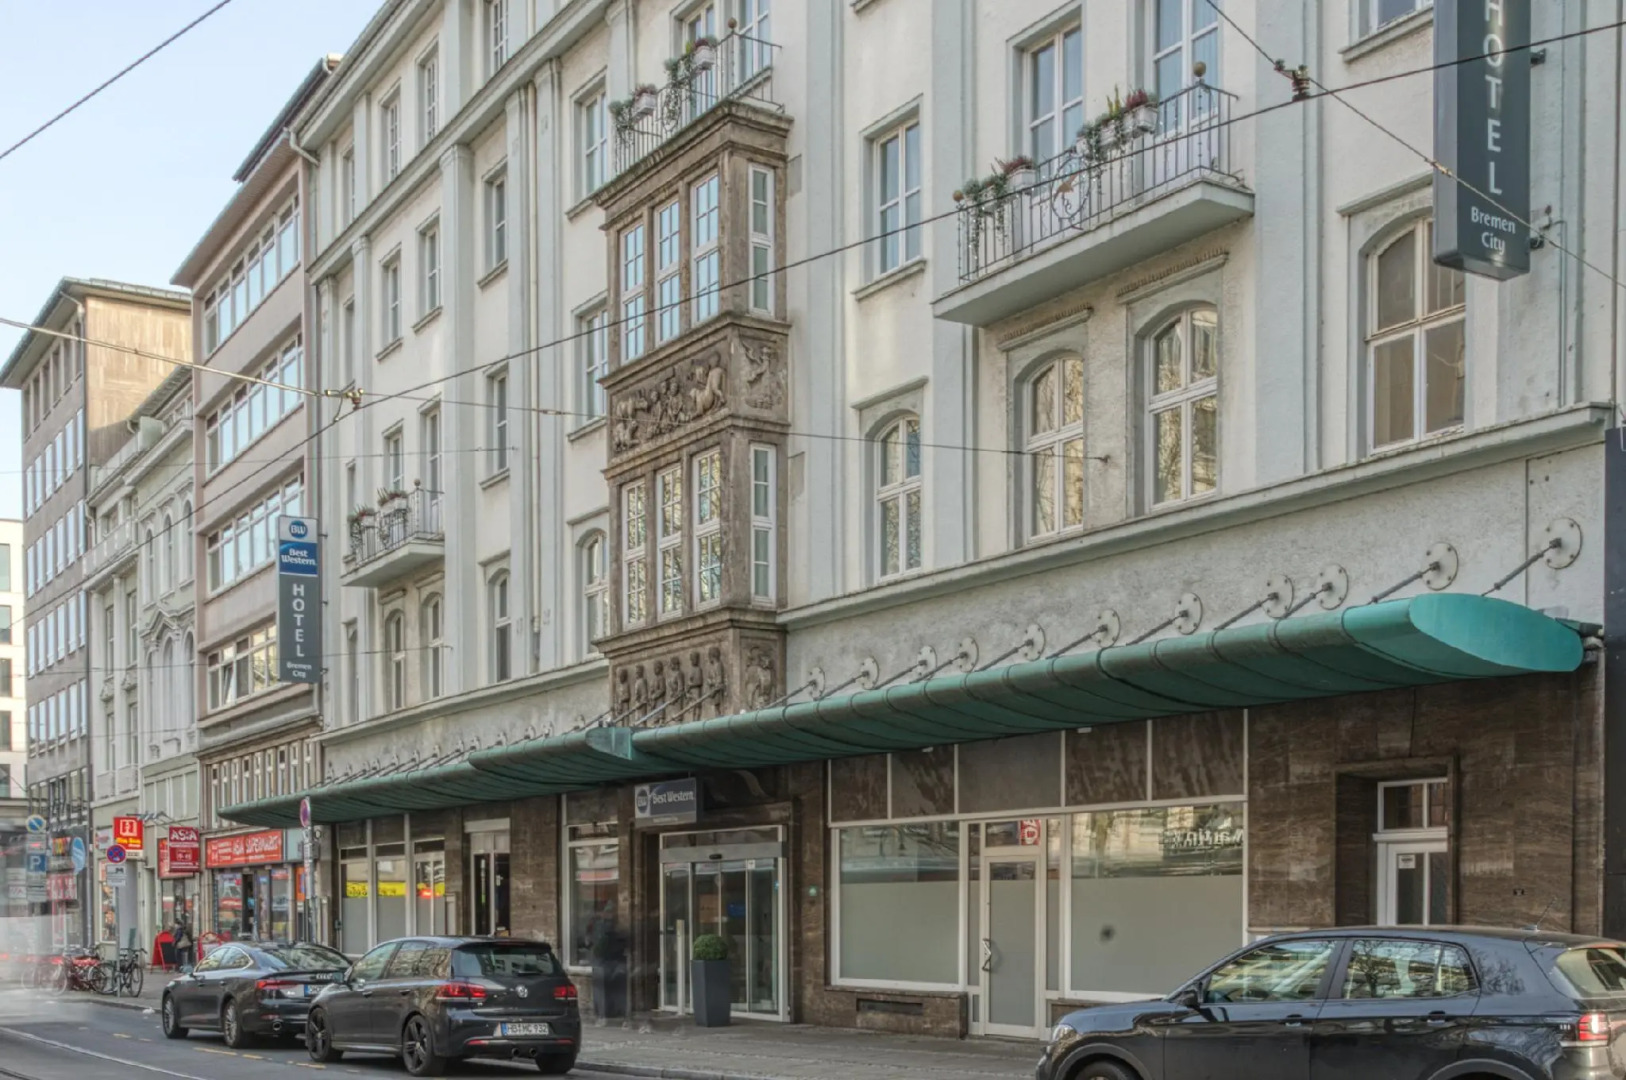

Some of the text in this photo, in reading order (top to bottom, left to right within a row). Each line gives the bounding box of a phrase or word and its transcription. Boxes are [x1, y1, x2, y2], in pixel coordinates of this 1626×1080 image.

[1483, 0, 1504, 195] HOTEL
[1471, 206, 1516, 234] Bremen
[1481, 231, 1506, 254] City
[291, 524, 306, 535] BW
[289, 548, 308, 558] Best
[281, 554, 316, 566] Western
[292, 584, 305, 657] HOTEL
[286, 661, 312, 671] Bremen
[292, 669, 306, 679] City
[652, 790, 695, 805] Best Western
[170, 829, 197, 841] ASIA
[29, 855, 42, 871] P
